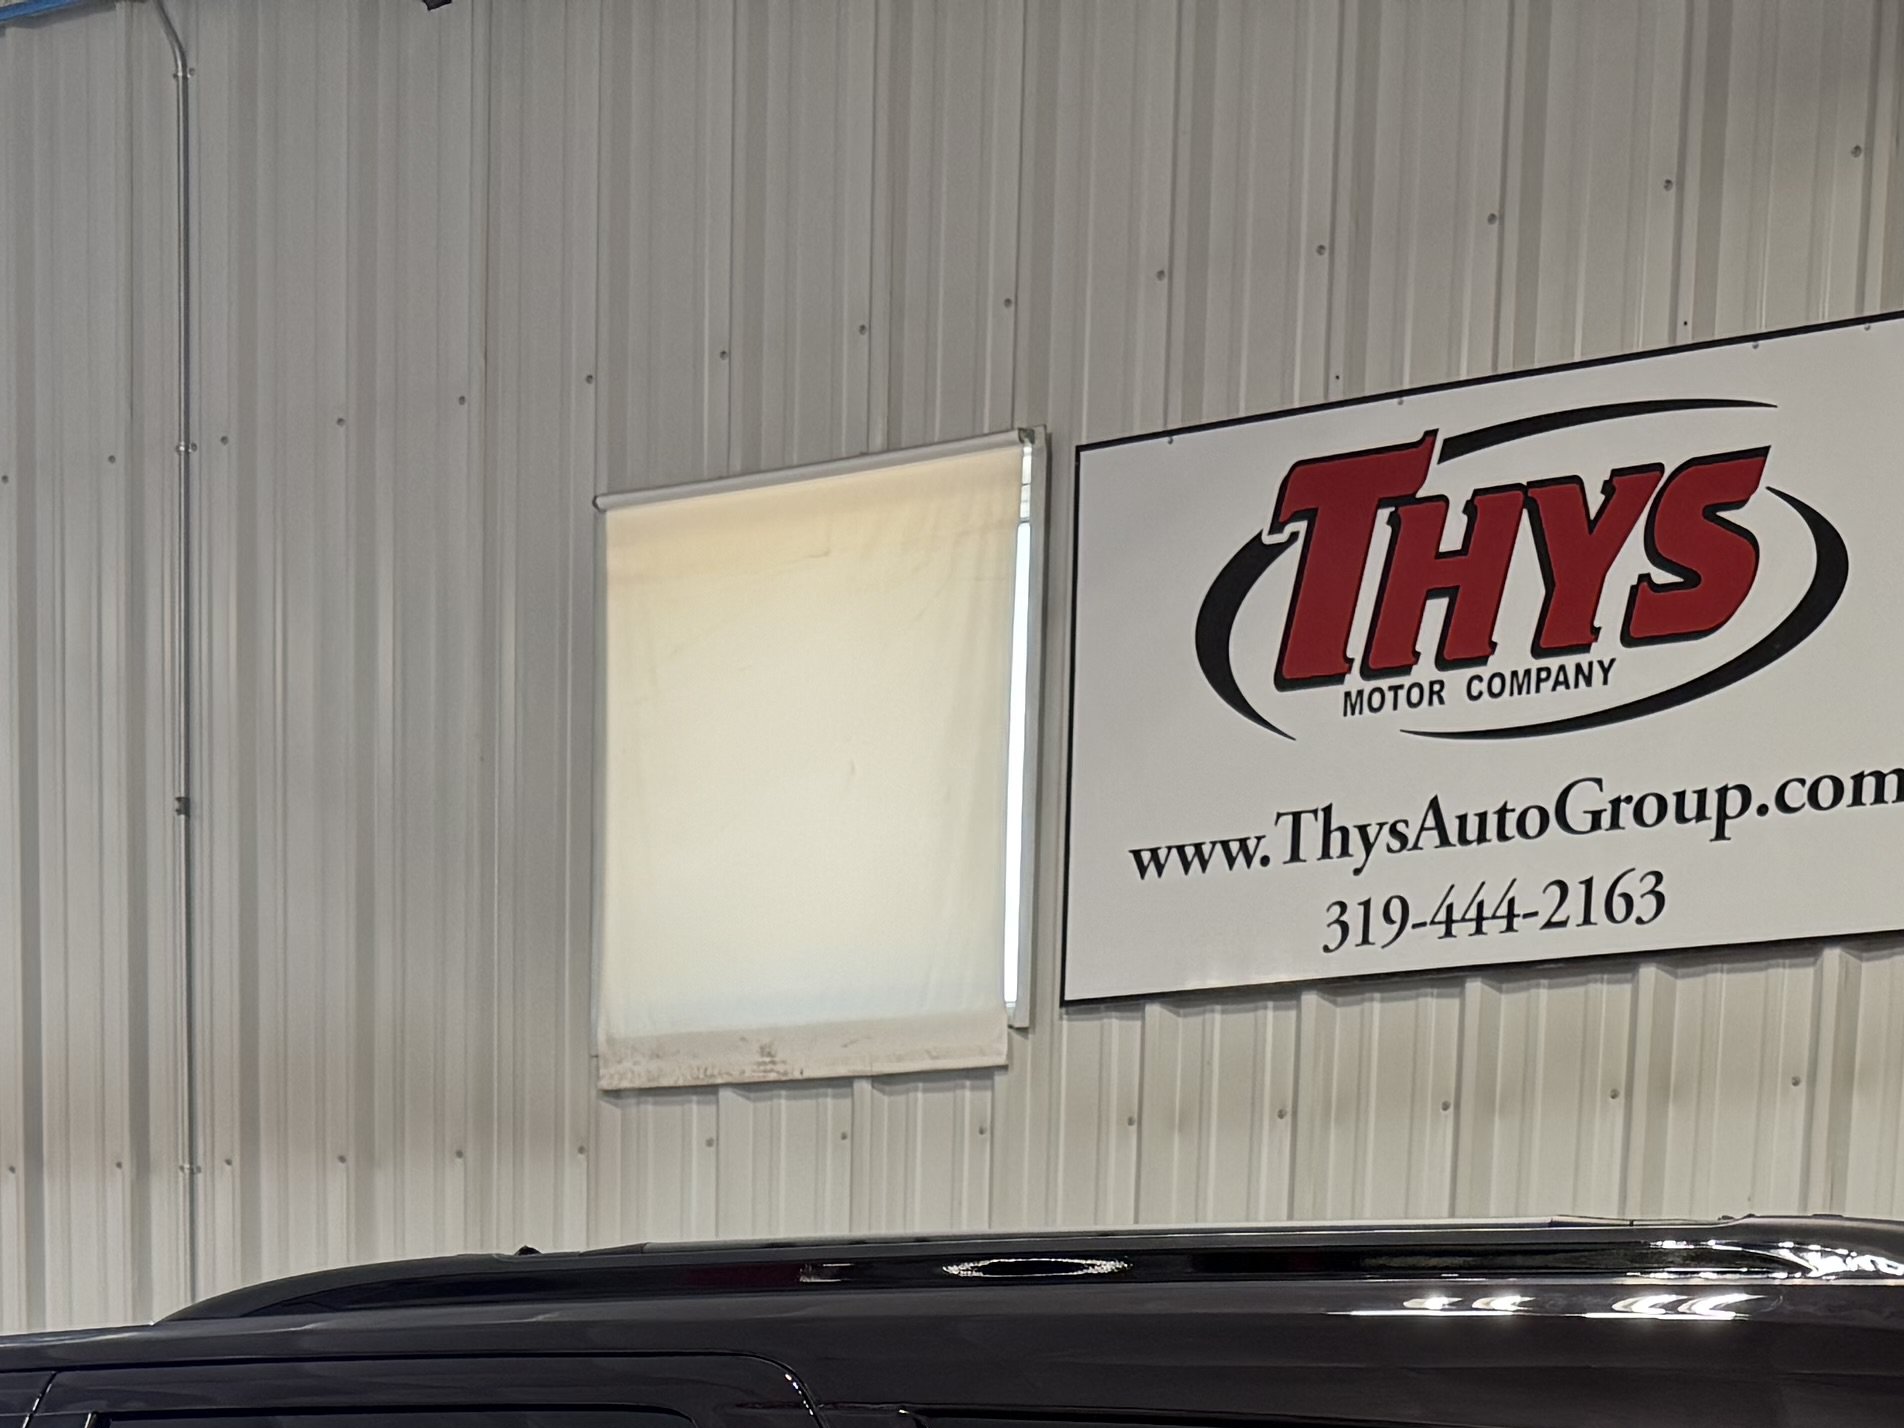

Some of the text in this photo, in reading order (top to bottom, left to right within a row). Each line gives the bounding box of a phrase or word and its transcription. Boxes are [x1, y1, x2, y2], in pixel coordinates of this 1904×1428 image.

[1264, 428, 1772, 692] THYS
[1342, 658, 1617, 718] MOTOR COMPANY
[1322, 869, 1667, 954] 319-444-2163
